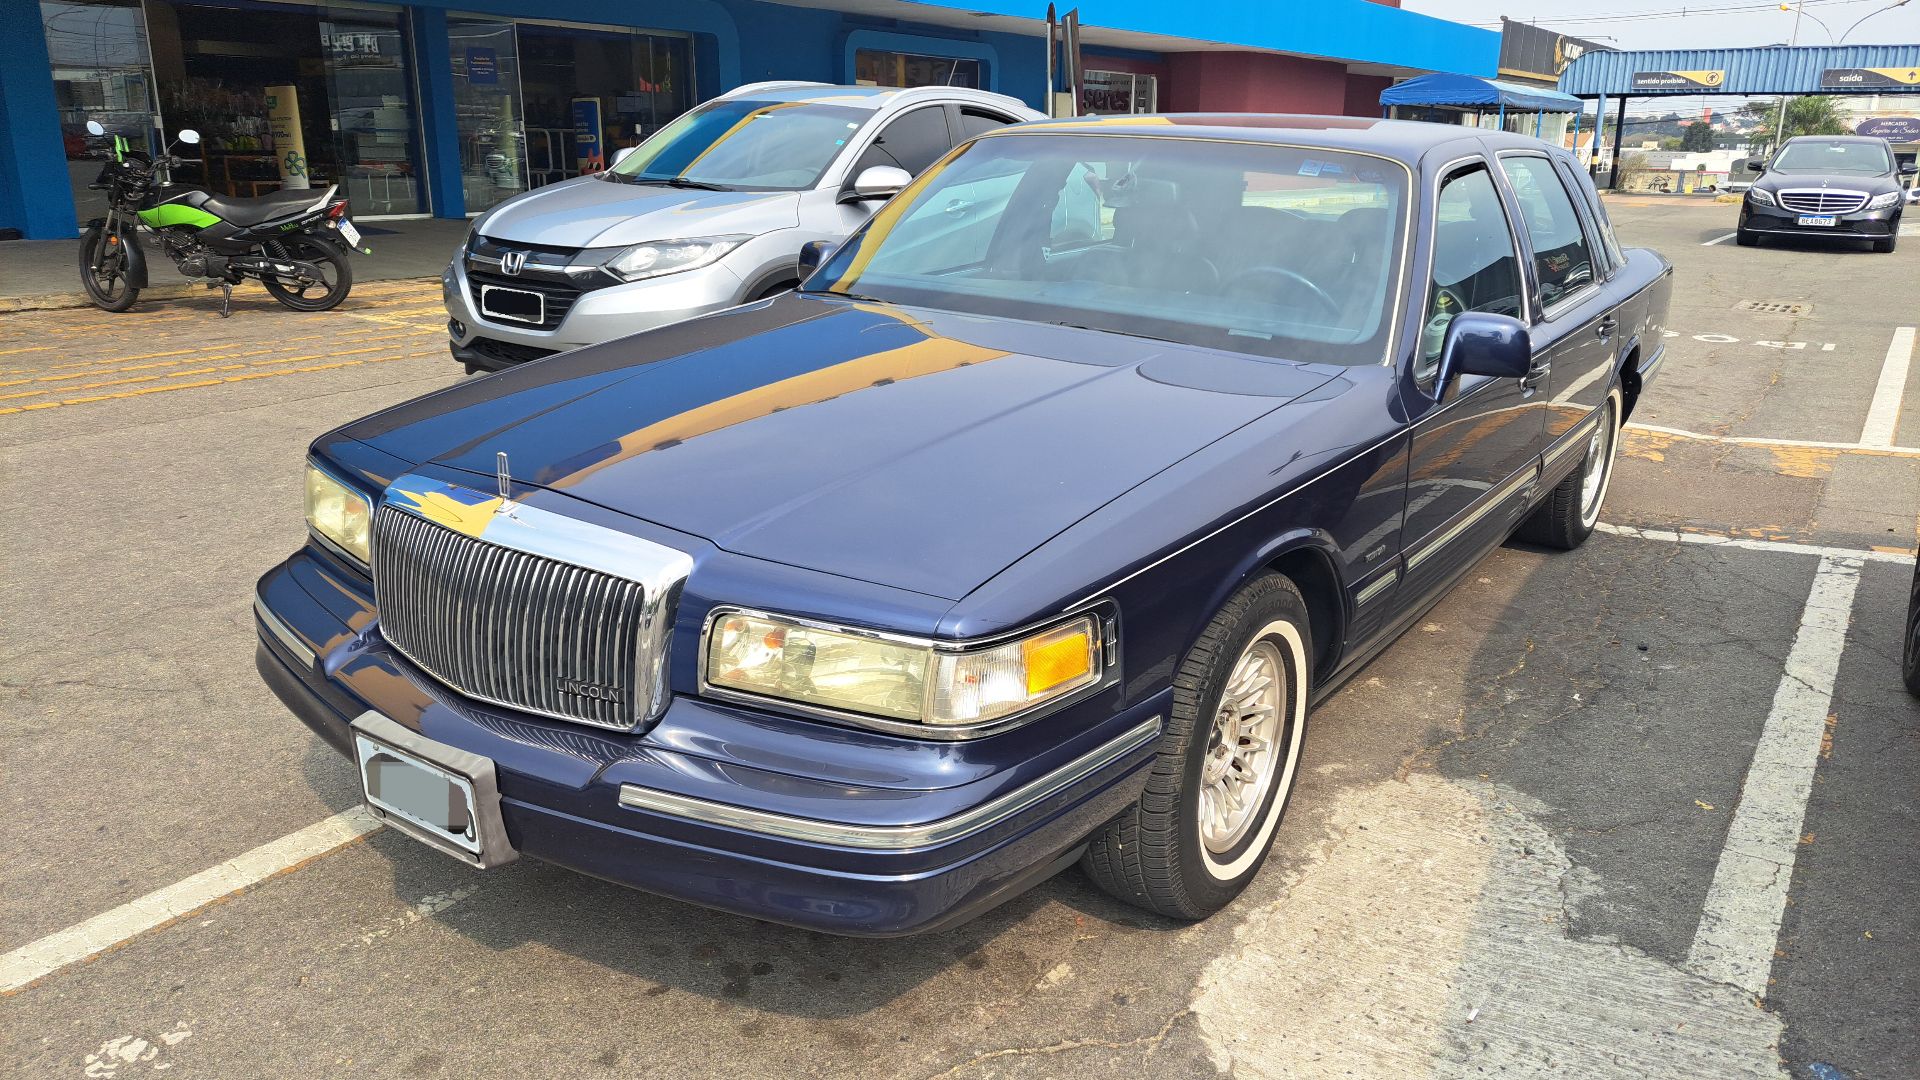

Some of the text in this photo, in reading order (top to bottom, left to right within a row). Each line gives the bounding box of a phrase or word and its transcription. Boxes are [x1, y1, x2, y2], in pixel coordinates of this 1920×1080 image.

[1637, 77, 1686, 86] sentido proibido
[1839, 73, 1863, 82] saída
[556, 679, 619, 702] LINCOLN
